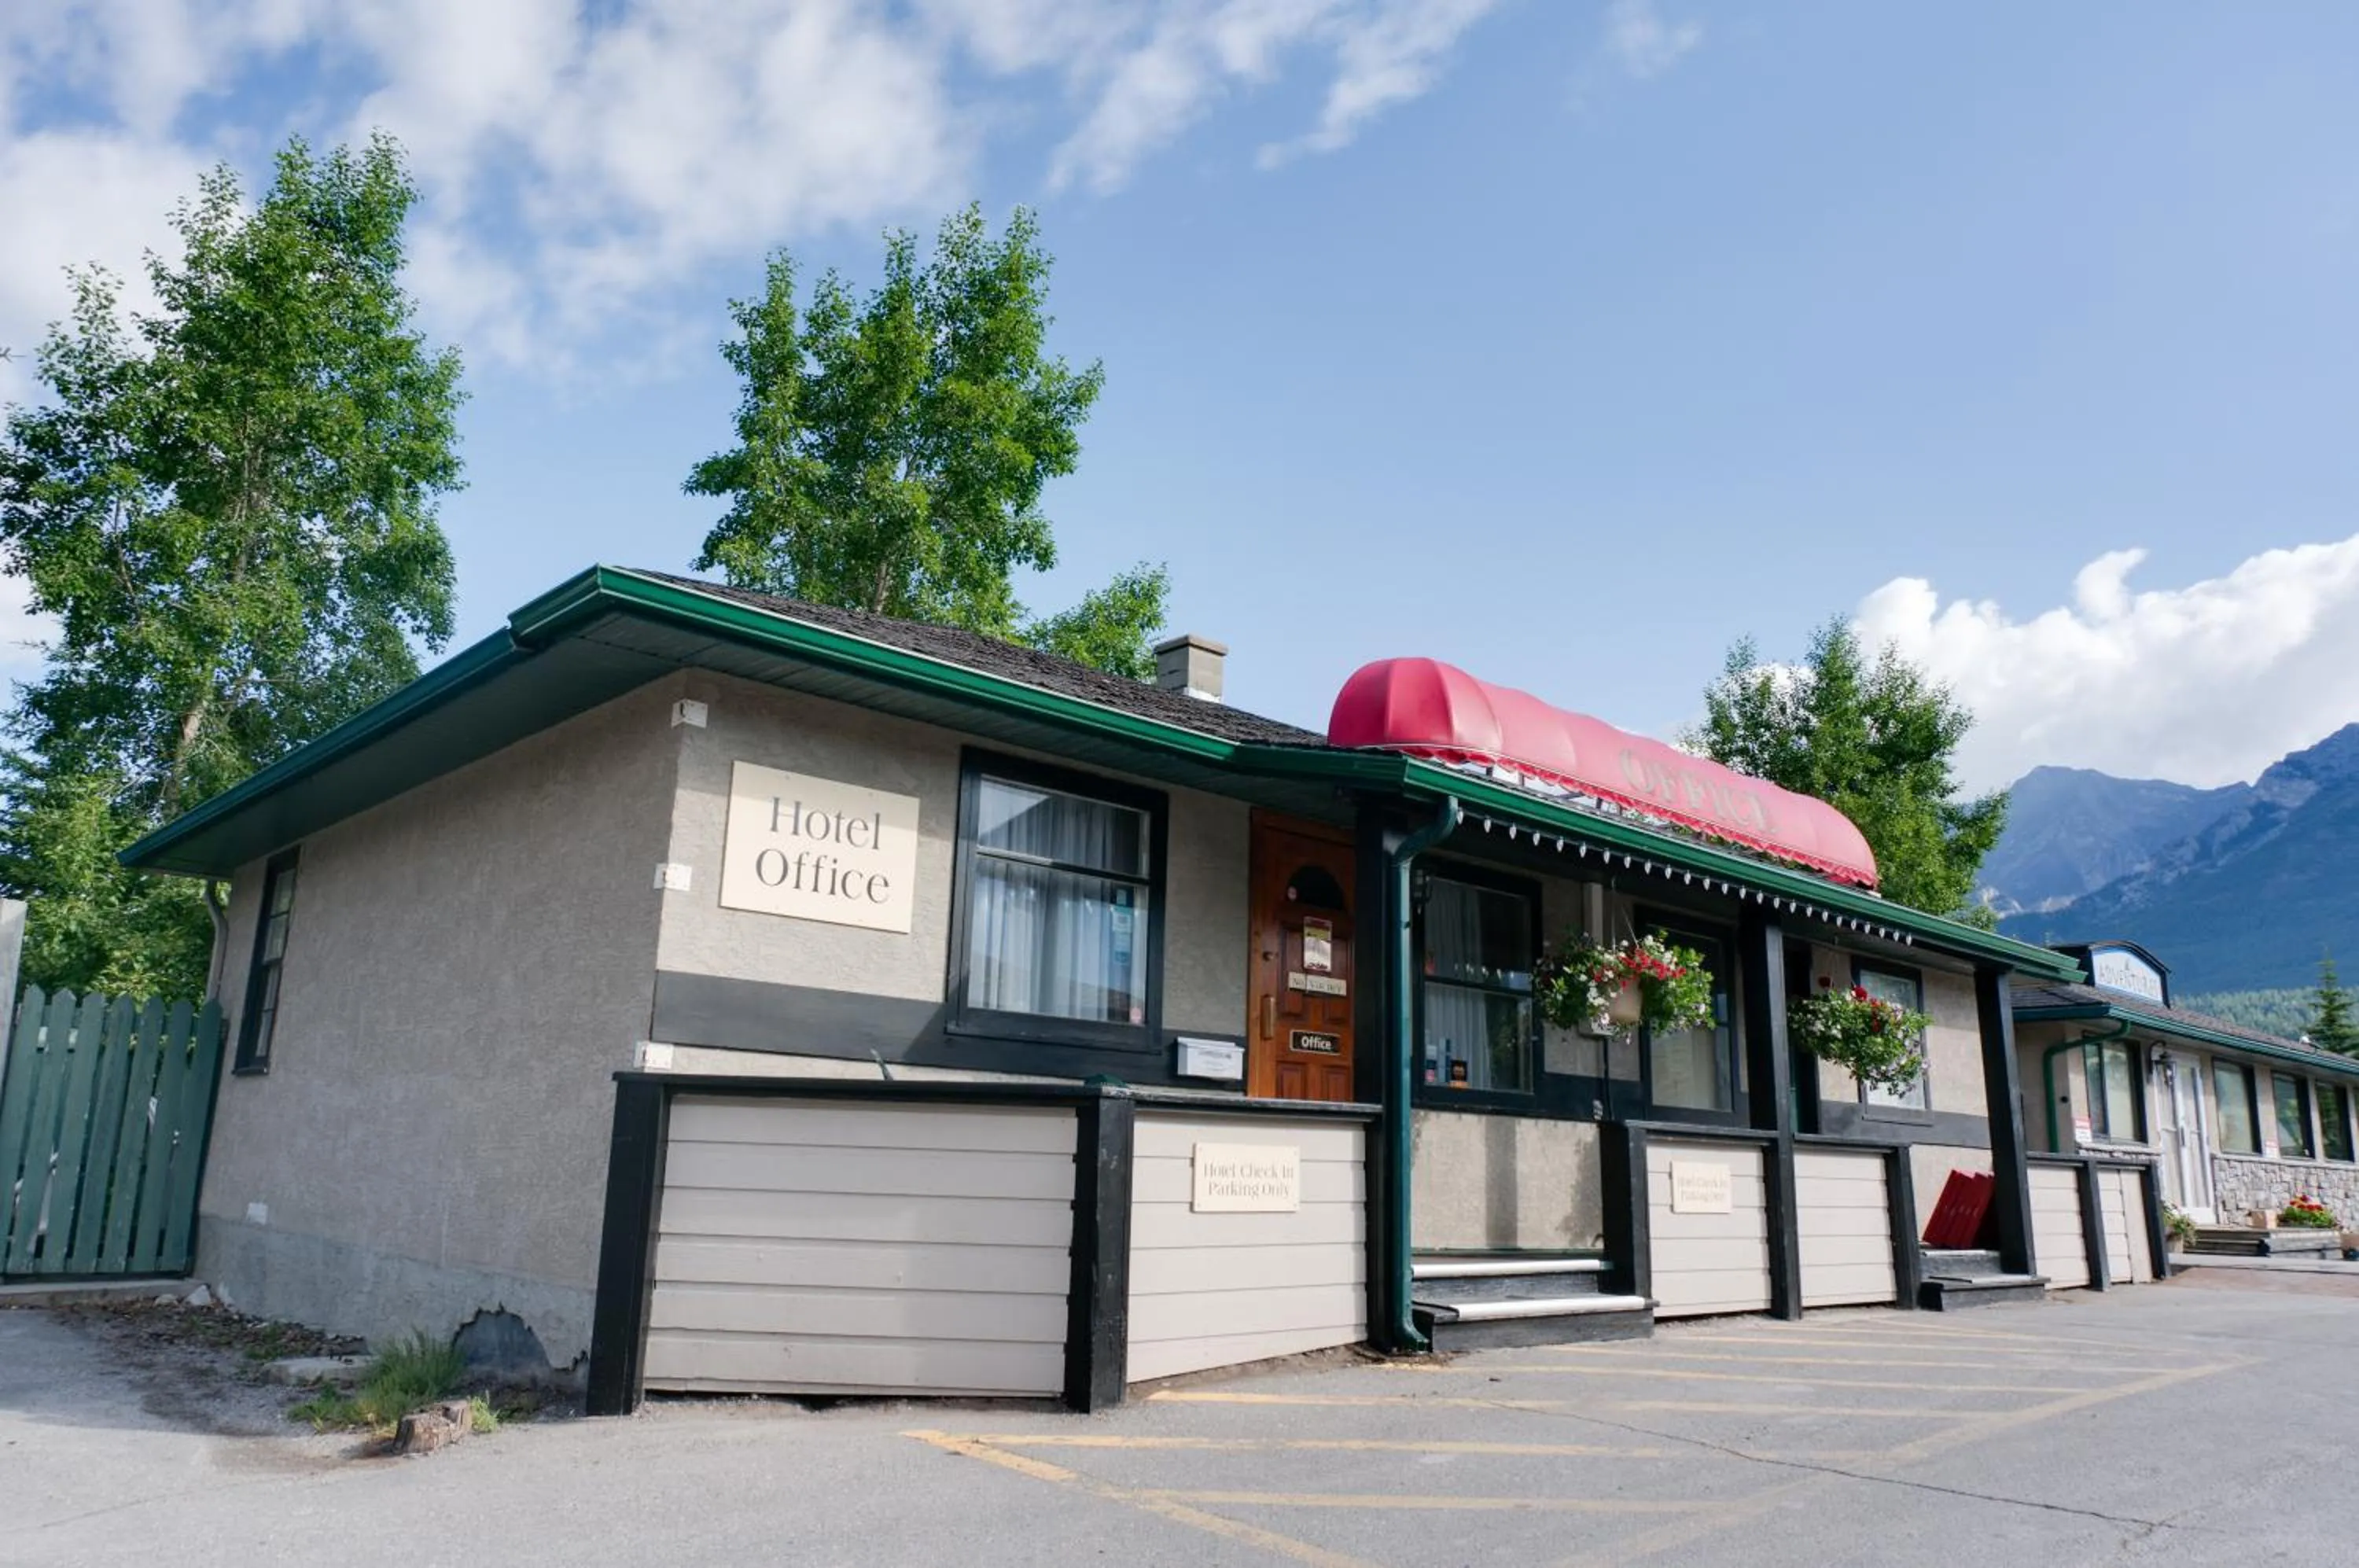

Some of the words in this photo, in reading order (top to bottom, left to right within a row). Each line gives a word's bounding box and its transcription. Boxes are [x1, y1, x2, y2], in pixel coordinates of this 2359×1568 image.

[769, 797, 881, 850] Hotel
[755, 848, 890, 904] Office
[1301, 1036, 1331, 1051] Office
[1204, 1162, 1235, 1178] Hotel
[1240, 1162, 1278, 1179] Check
[1283, 1163, 1294, 1179] In
[1209, 1180, 1259, 1201] Parking
[1262, 1181, 1290, 1199] Only
